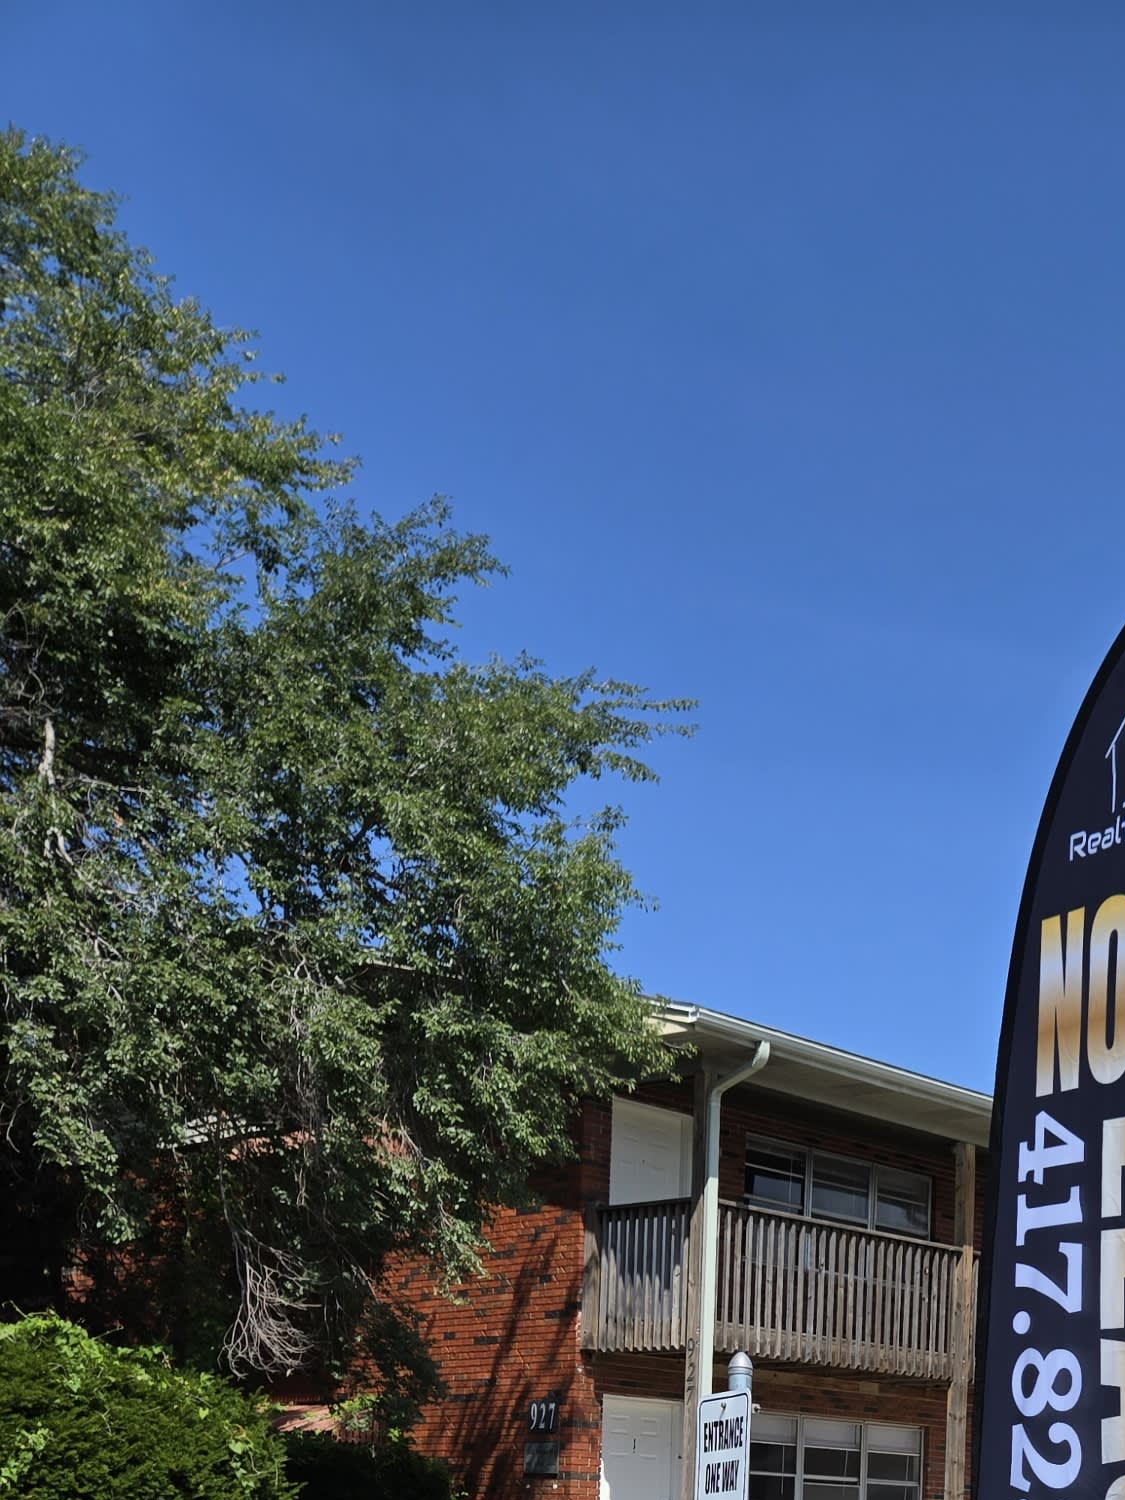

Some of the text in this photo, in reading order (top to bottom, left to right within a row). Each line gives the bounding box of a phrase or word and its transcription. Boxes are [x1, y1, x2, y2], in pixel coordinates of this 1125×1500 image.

[530, 1402, 556, 1430] 927
[704, 1416, 743, 1453] ENTRANCE
[705, 1460, 739, 1495] ONE WAY
